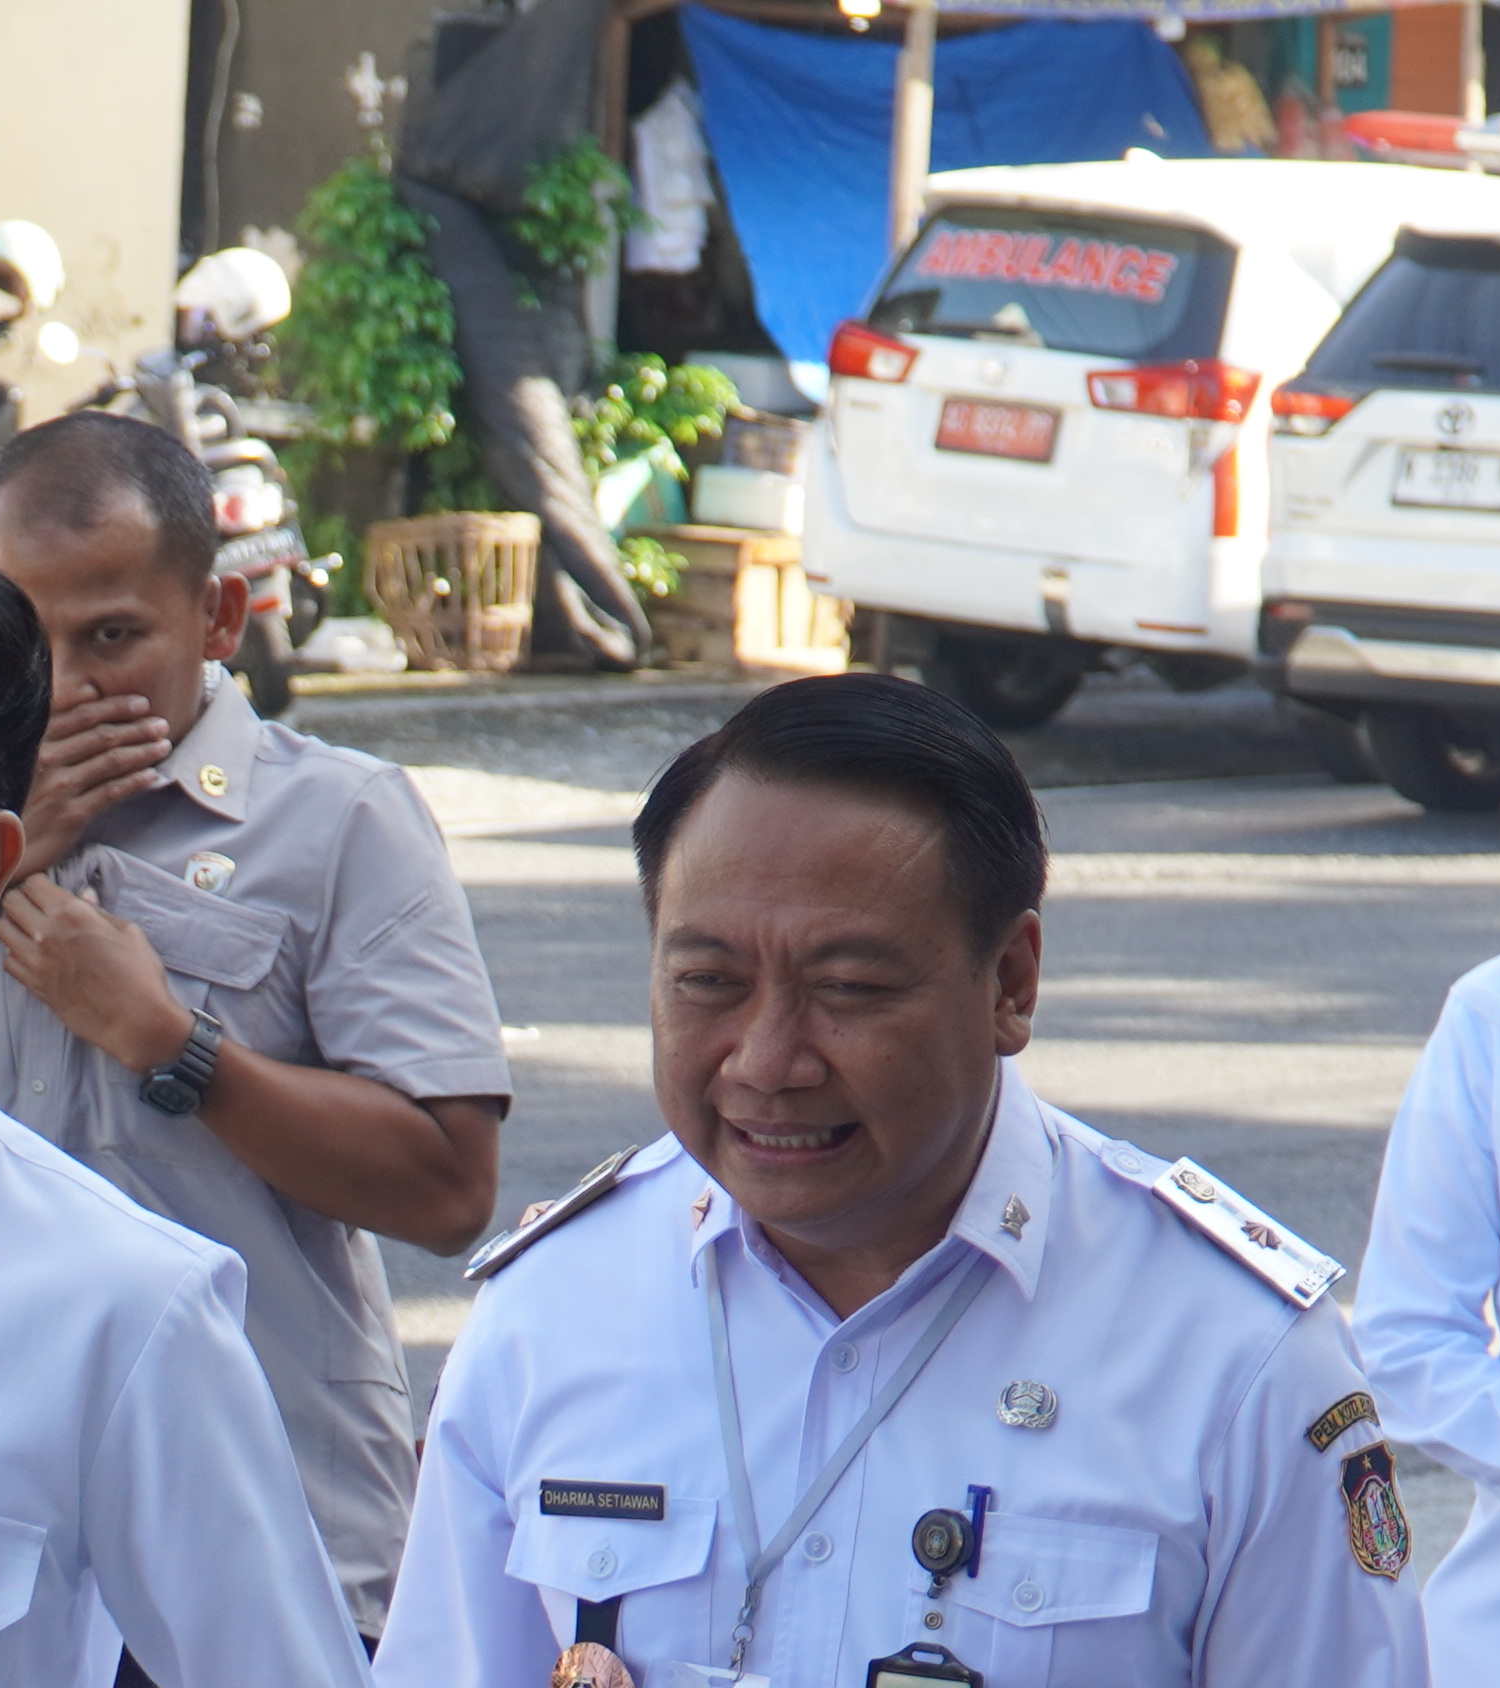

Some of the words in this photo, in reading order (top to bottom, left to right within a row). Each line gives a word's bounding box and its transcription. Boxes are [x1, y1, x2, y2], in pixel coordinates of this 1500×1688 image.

[917, 229, 1178, 304] AMBULANCE
[544, 1490, 595, 1507] DHARMA
[597, 1492, 659, 1510] SETIAWAN
